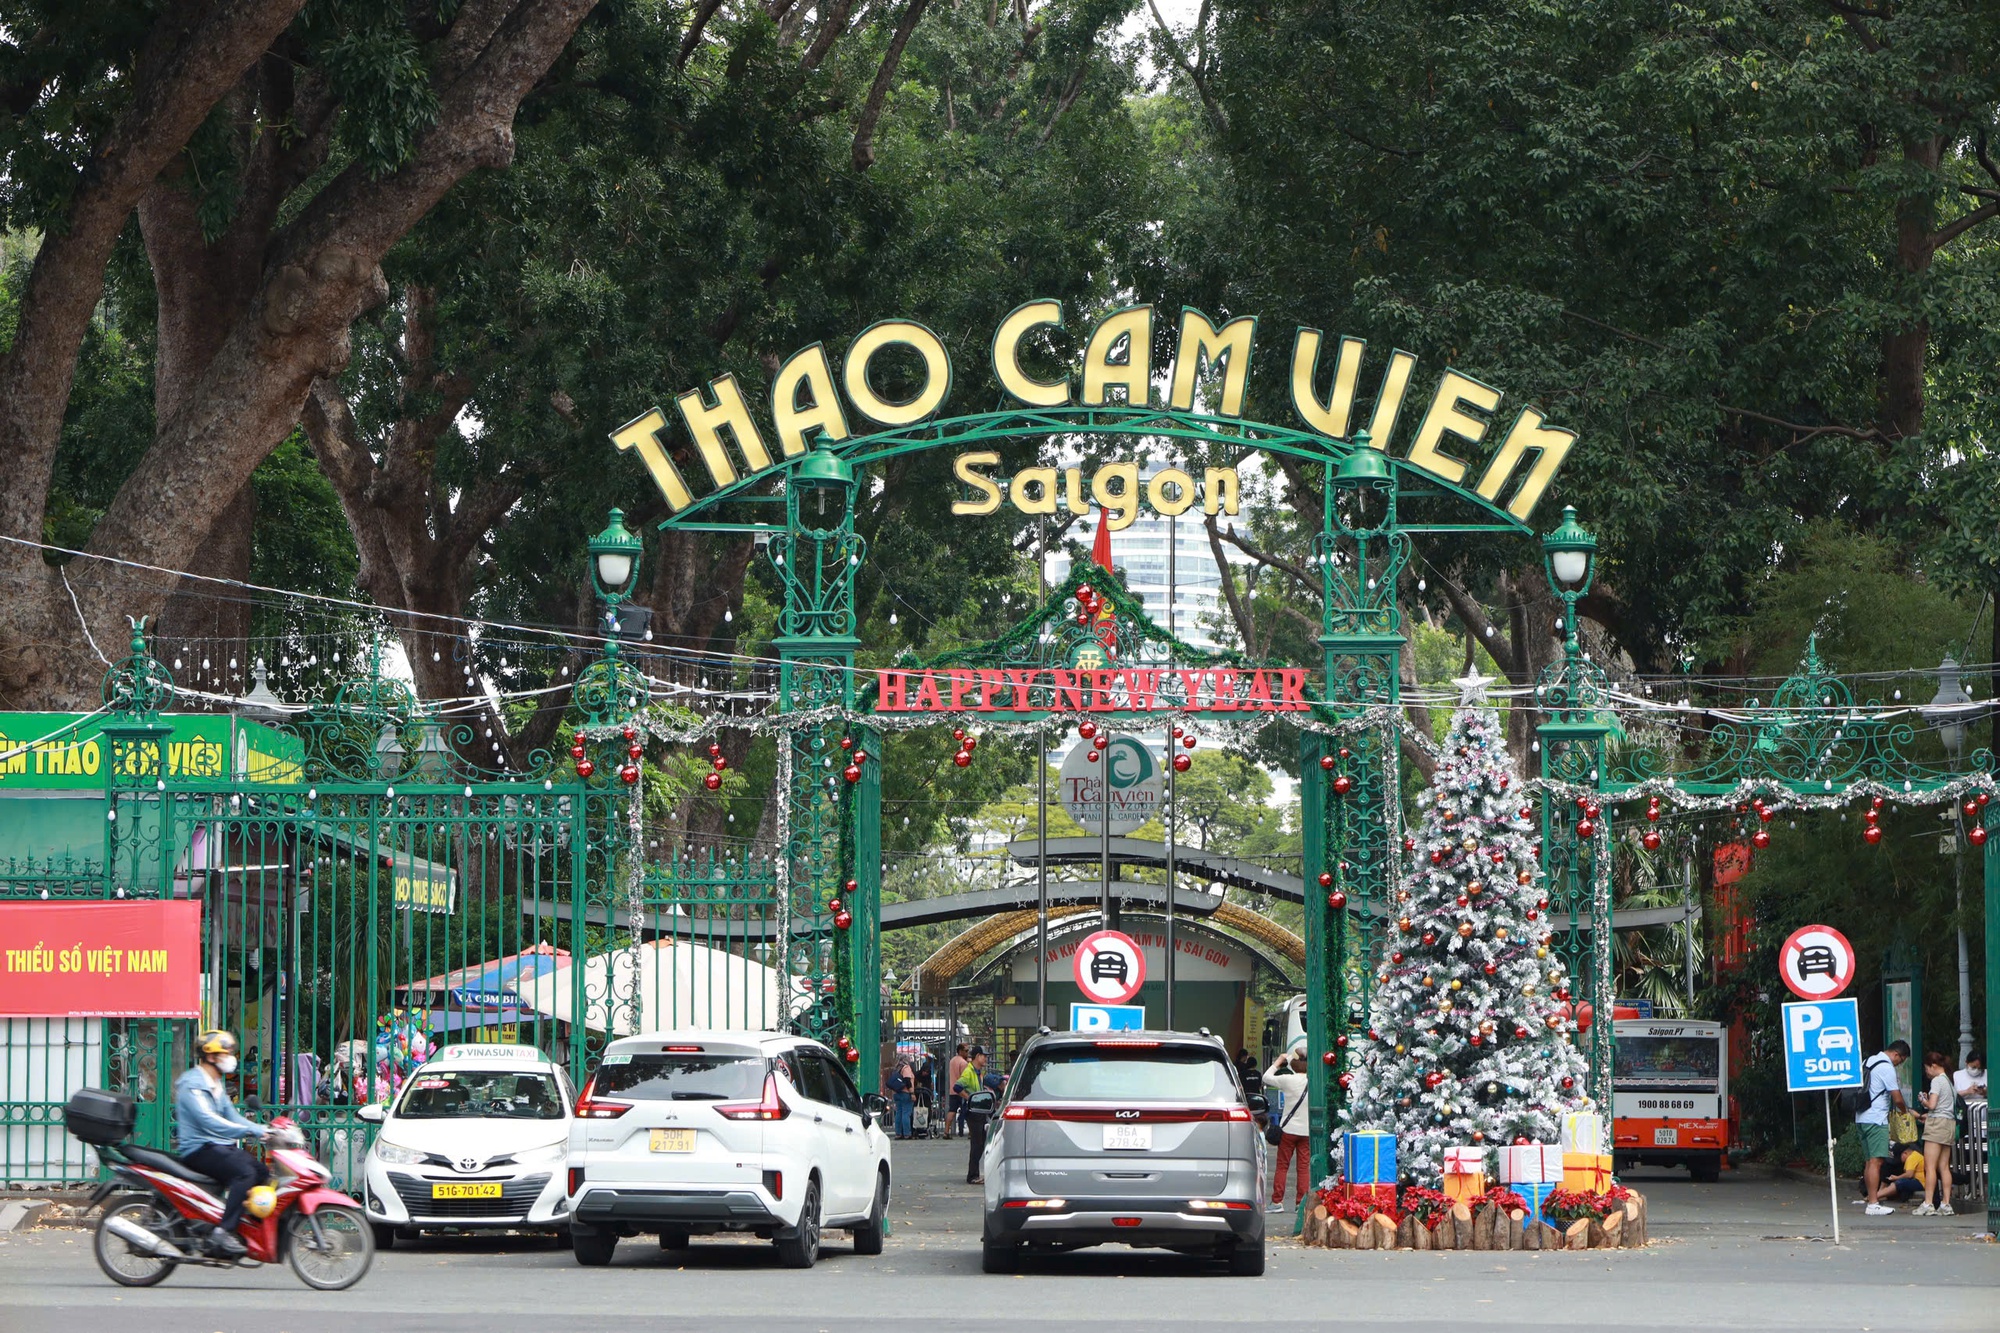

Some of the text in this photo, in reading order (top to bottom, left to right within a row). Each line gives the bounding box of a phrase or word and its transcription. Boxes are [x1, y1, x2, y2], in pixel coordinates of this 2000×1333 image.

[609, 317, 953, 514] THAO
[991, 296, 1260, 418] CAM
[950, 450, 1241, 532] Saigon
[874, 668, 1312, 712] HAPPY NEW YEAR
[35, 725, 101, 776] THẢO
[1071, 803, 1120, 811] SAIGN
[1155, 934, 1182, 950] VIN
[6, 940, 168, 978] THIỂU SỐ VIỆT NAM
[1789, 1005, 1823, 1053] P
[466, 1048, 536, 1058] VINASUN TAXI
[1804, 1057, 1851, 1074] 50m
[1638, 1100, 1694, 1109] 1900 88 68 69
[663, 1129, 684, 1140] 50H
[1116, 1126, 1138, 1137] 86A
[654, 1140, 690, 1151] 217.91
[438, 1185, 496, 1197] 51G-701.42
